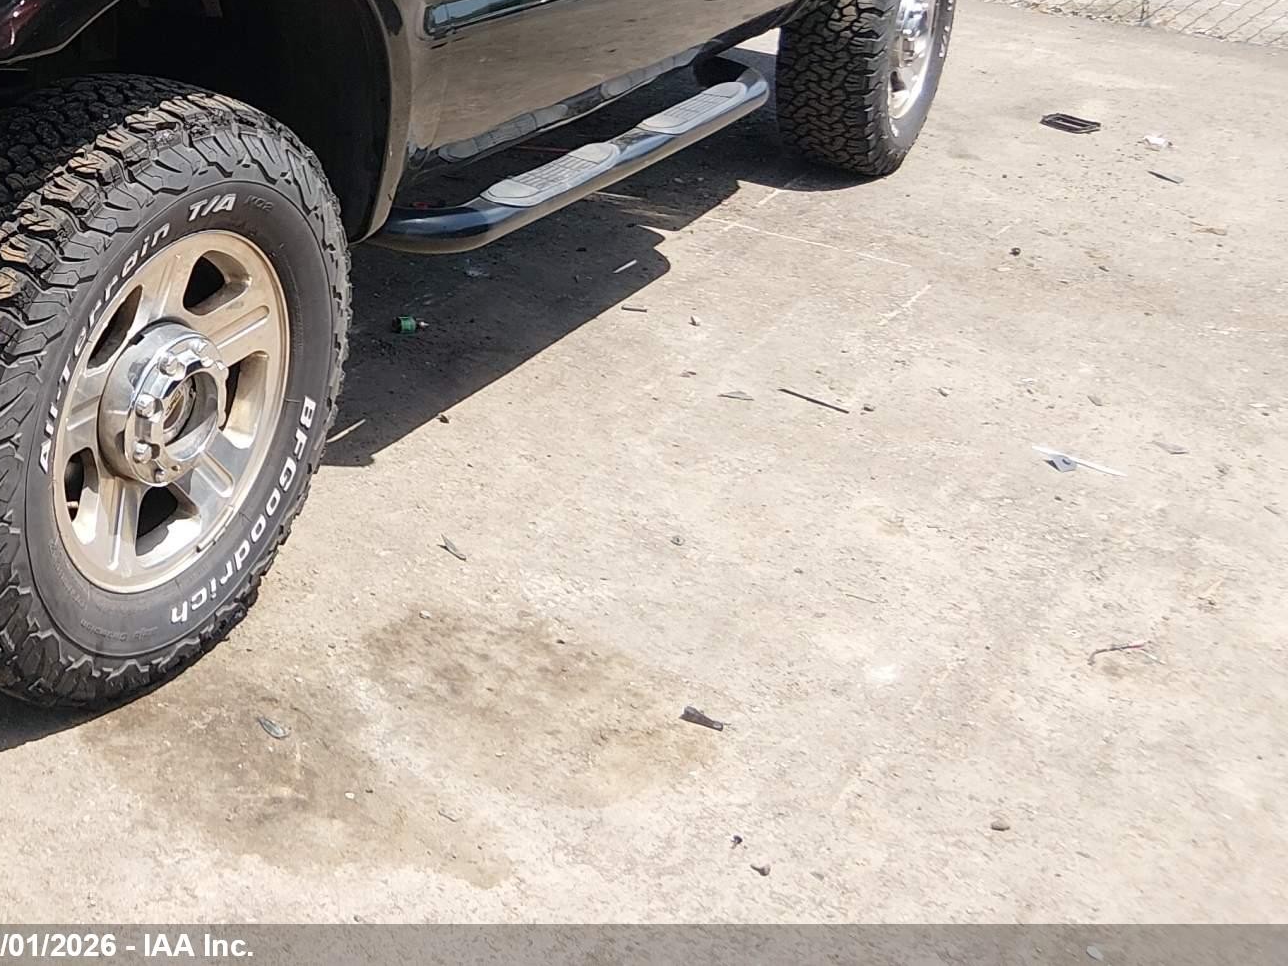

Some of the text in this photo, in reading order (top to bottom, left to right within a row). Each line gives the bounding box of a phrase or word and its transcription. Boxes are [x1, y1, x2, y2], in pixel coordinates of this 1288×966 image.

[40, 222, 171, 474] All-Terrain
[188, 193, 237, 222] T/A
[171, 395, 317, 625] BFGoodrich
